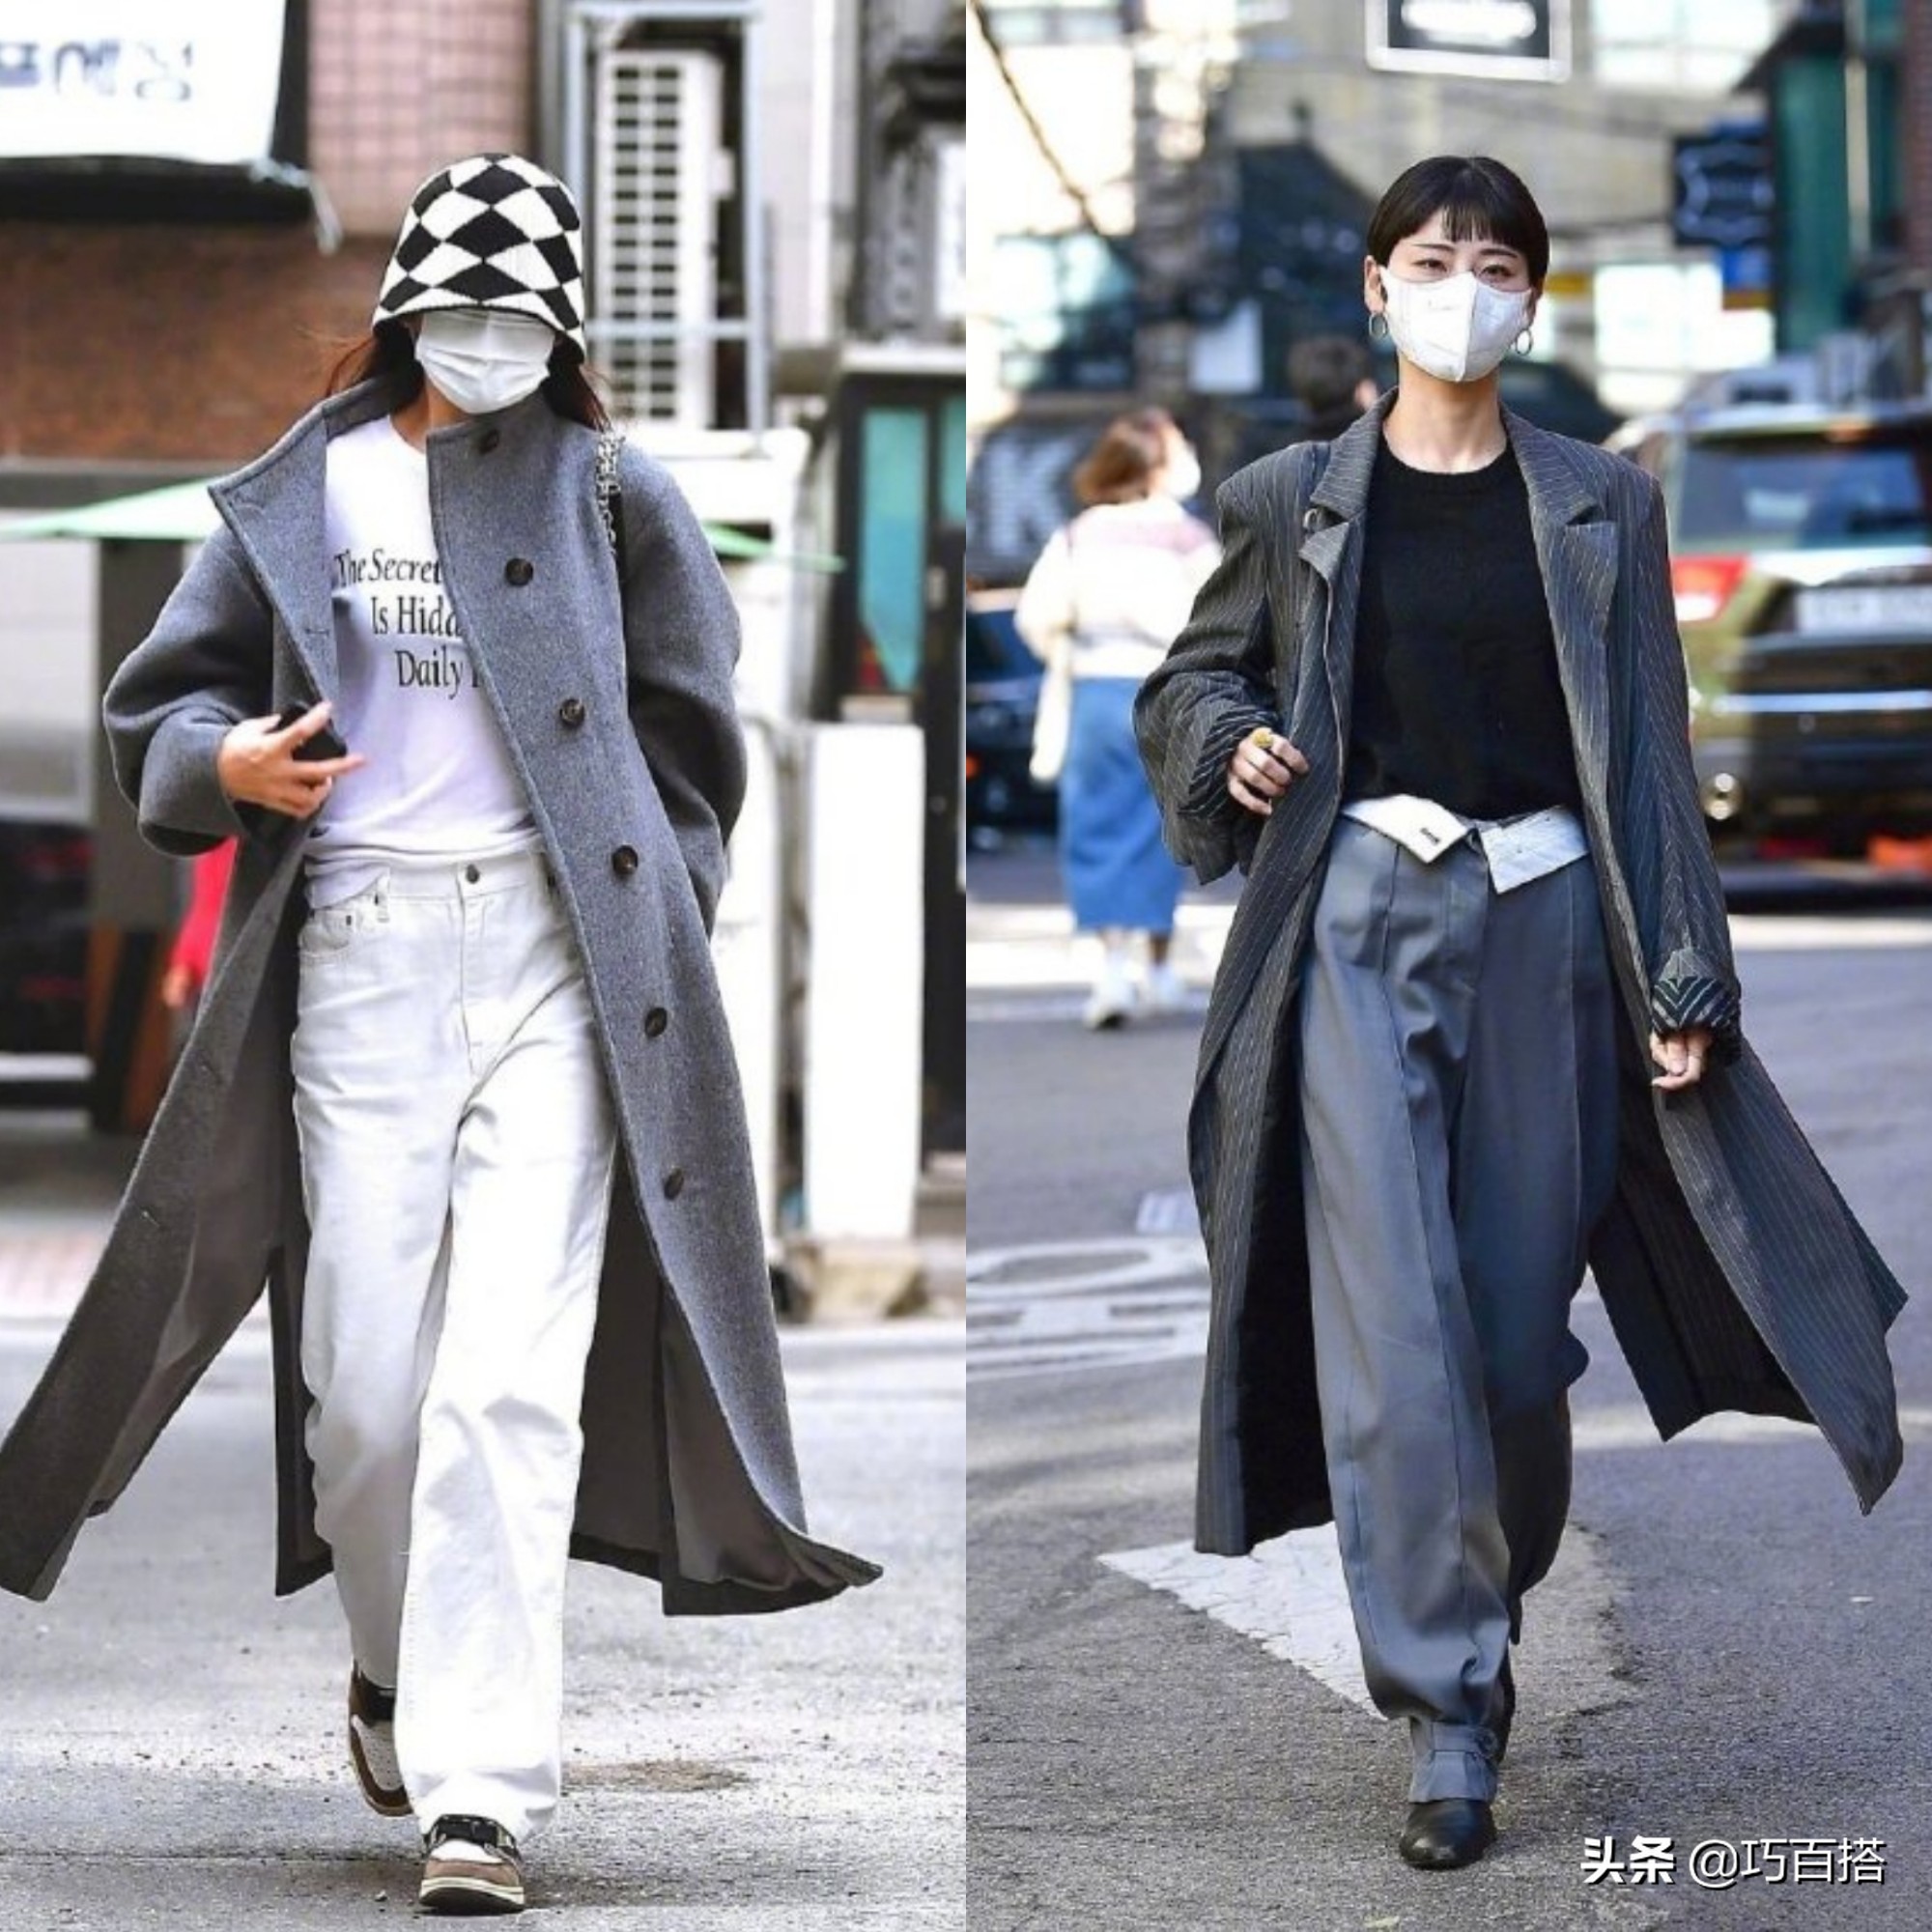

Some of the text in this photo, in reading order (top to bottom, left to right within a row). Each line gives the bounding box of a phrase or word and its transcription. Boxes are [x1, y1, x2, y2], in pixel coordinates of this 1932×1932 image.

[334, 549, 366, 587] The
[371, 596, 388, 635] Is
[395, 644, 464, 700] Daily
